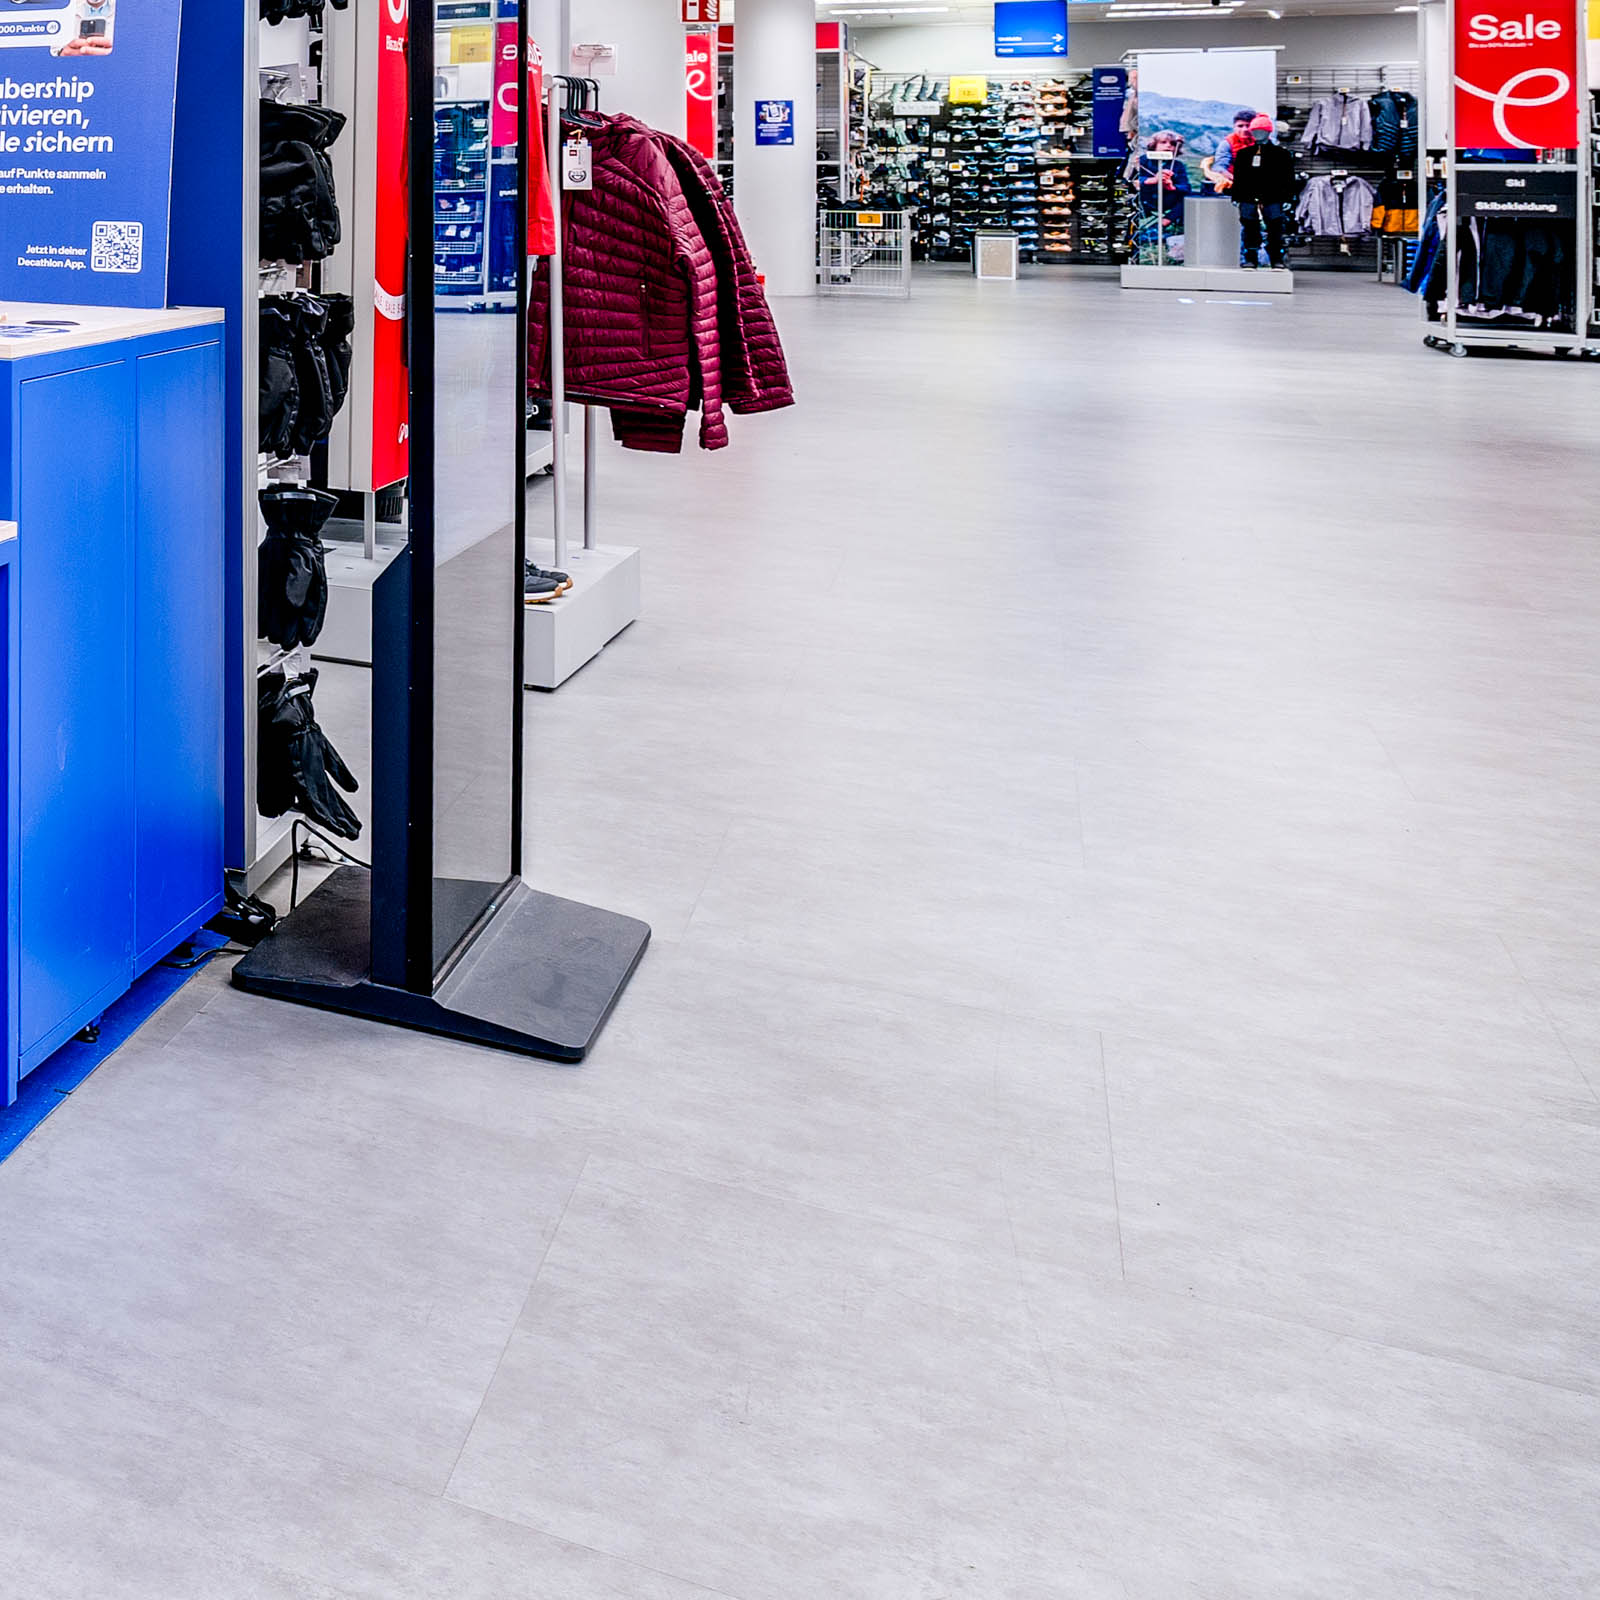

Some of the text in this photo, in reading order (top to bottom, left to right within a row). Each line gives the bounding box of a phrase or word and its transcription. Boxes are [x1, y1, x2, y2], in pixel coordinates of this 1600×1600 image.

[16, 24, 45, 34] Punkte
[1468, 13, 1562, 41] Sale
[685, 50, 708, 62] ale
[23, 130, 114, 153] sichern
[16, 168, 56, 179] Punkte
[56, 168, 107, 180] sammeln
[6, 183, 54, 195] erhalten.
[1505, 179, 1526, 188] Ski
[1475, 201, 1557, 213] Skibekleidung
[26, 245, 88, 256] Jetzt in deiner
[17, 257, 87, 270] Decathlon App.
